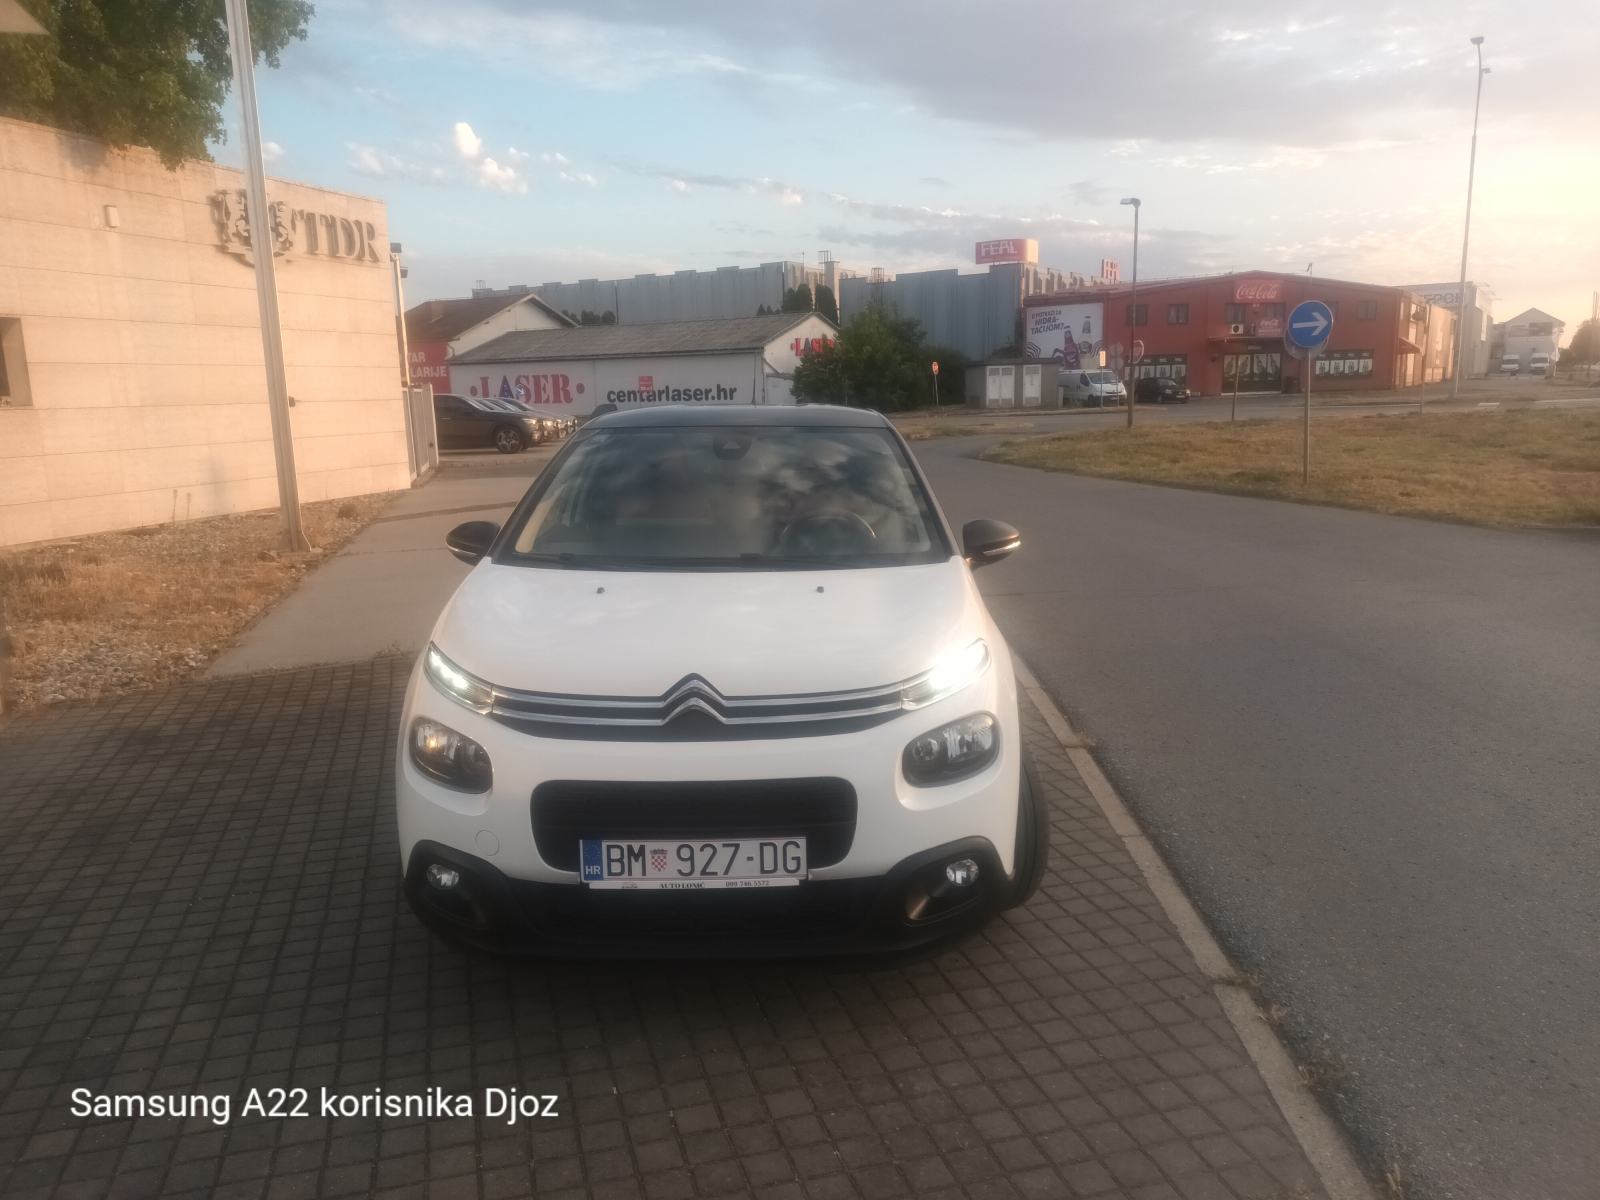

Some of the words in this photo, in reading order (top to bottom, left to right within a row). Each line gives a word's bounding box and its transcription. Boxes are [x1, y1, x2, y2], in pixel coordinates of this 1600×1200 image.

[480, 374, 574, 404] LASER
[606, 383, 738, 403] centarlaser.hr
[585, 865, 601, 875] HR
[606, 844, 647, 877] BM
